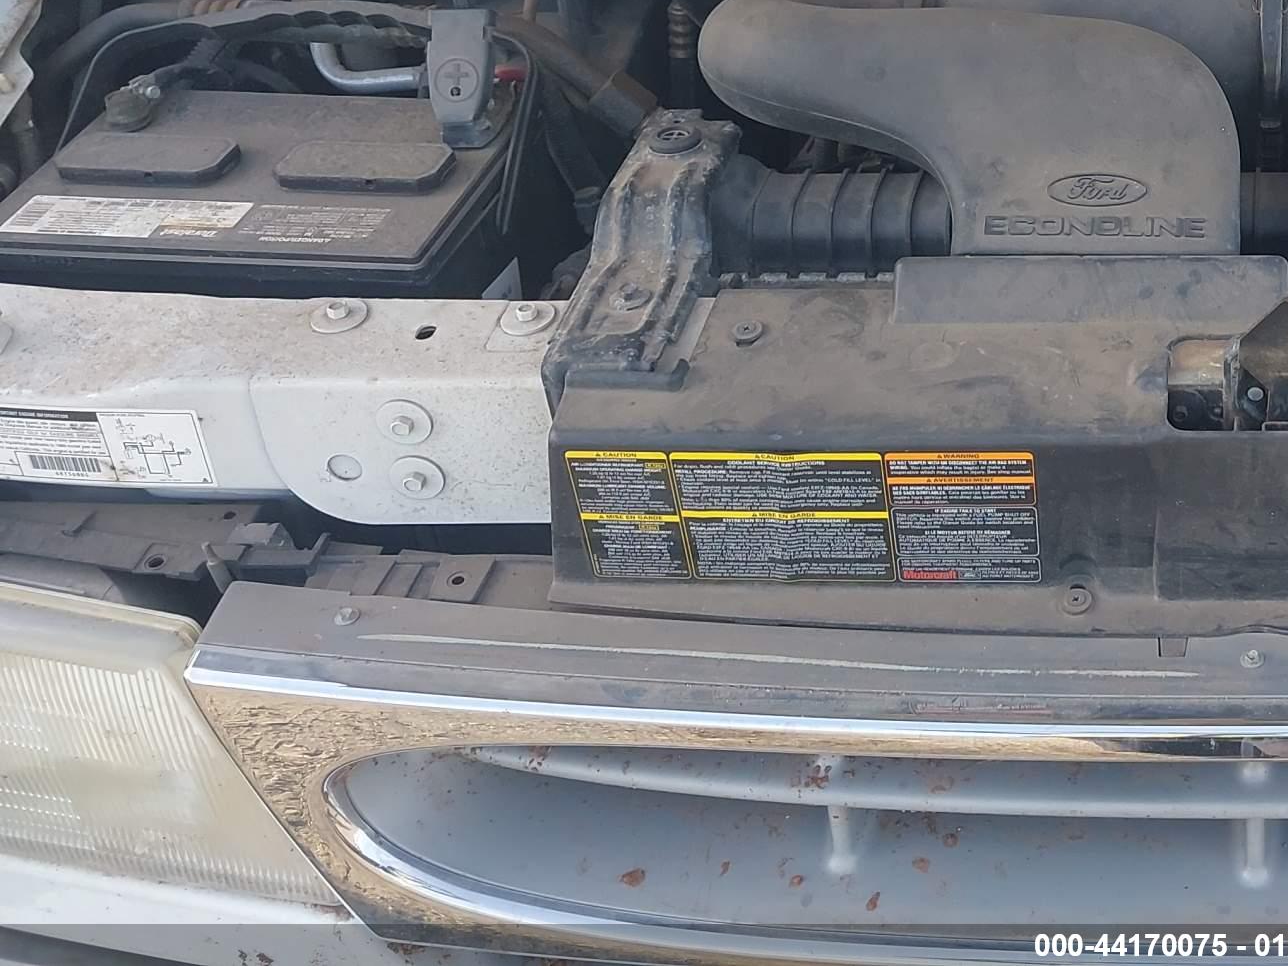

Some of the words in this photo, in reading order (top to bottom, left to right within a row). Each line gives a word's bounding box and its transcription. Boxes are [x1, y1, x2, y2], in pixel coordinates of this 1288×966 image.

[1067, 177, 1130, 200] Ford
[984, 216, 1208, 238] ECONOLINE
[903, 570, 956, 579] Motorcraft
